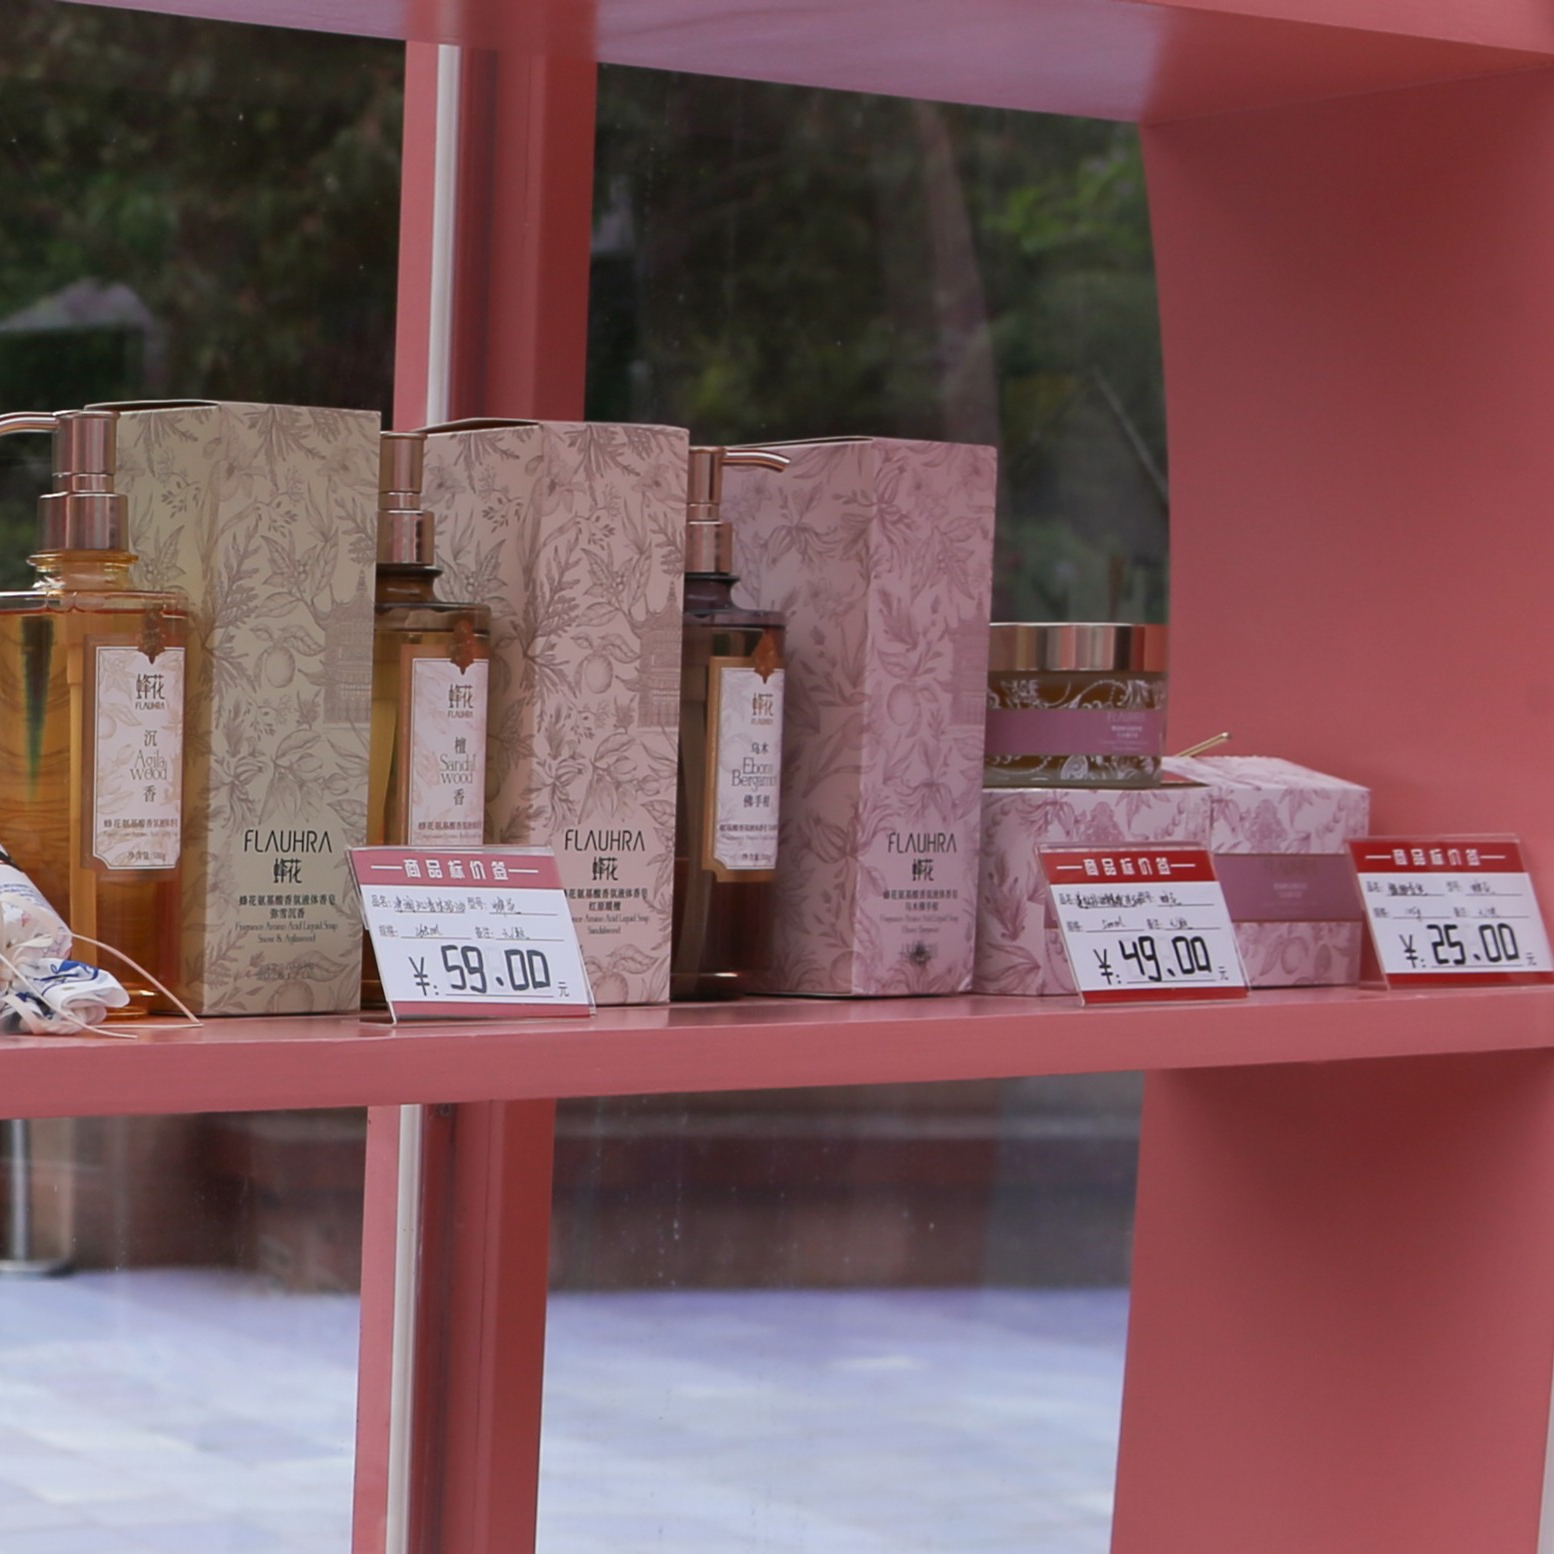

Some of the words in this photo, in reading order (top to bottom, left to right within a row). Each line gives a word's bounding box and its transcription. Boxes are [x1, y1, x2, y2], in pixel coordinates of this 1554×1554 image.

[136, 673, 165, 700] 蜂花
[448, 684, 474, 709] 蜂花
[244, 829, 332, 853] FLAUHRA
[565, 829, 645, 851] FLAUHRA
[888, 832, 957, 854] FLAUHRA
[273, 858, 302, 884] 蜂花
[404, 859, 509, 880] 商品标价签
[592, 856, 618, 881] 蜂花
[1426, 923, 1520, 965] 25.00
[441, 944, 551, 994] 59.00
[557, 981, 570, 997] 元
[1118, 935, 1212, 982] 49.00
